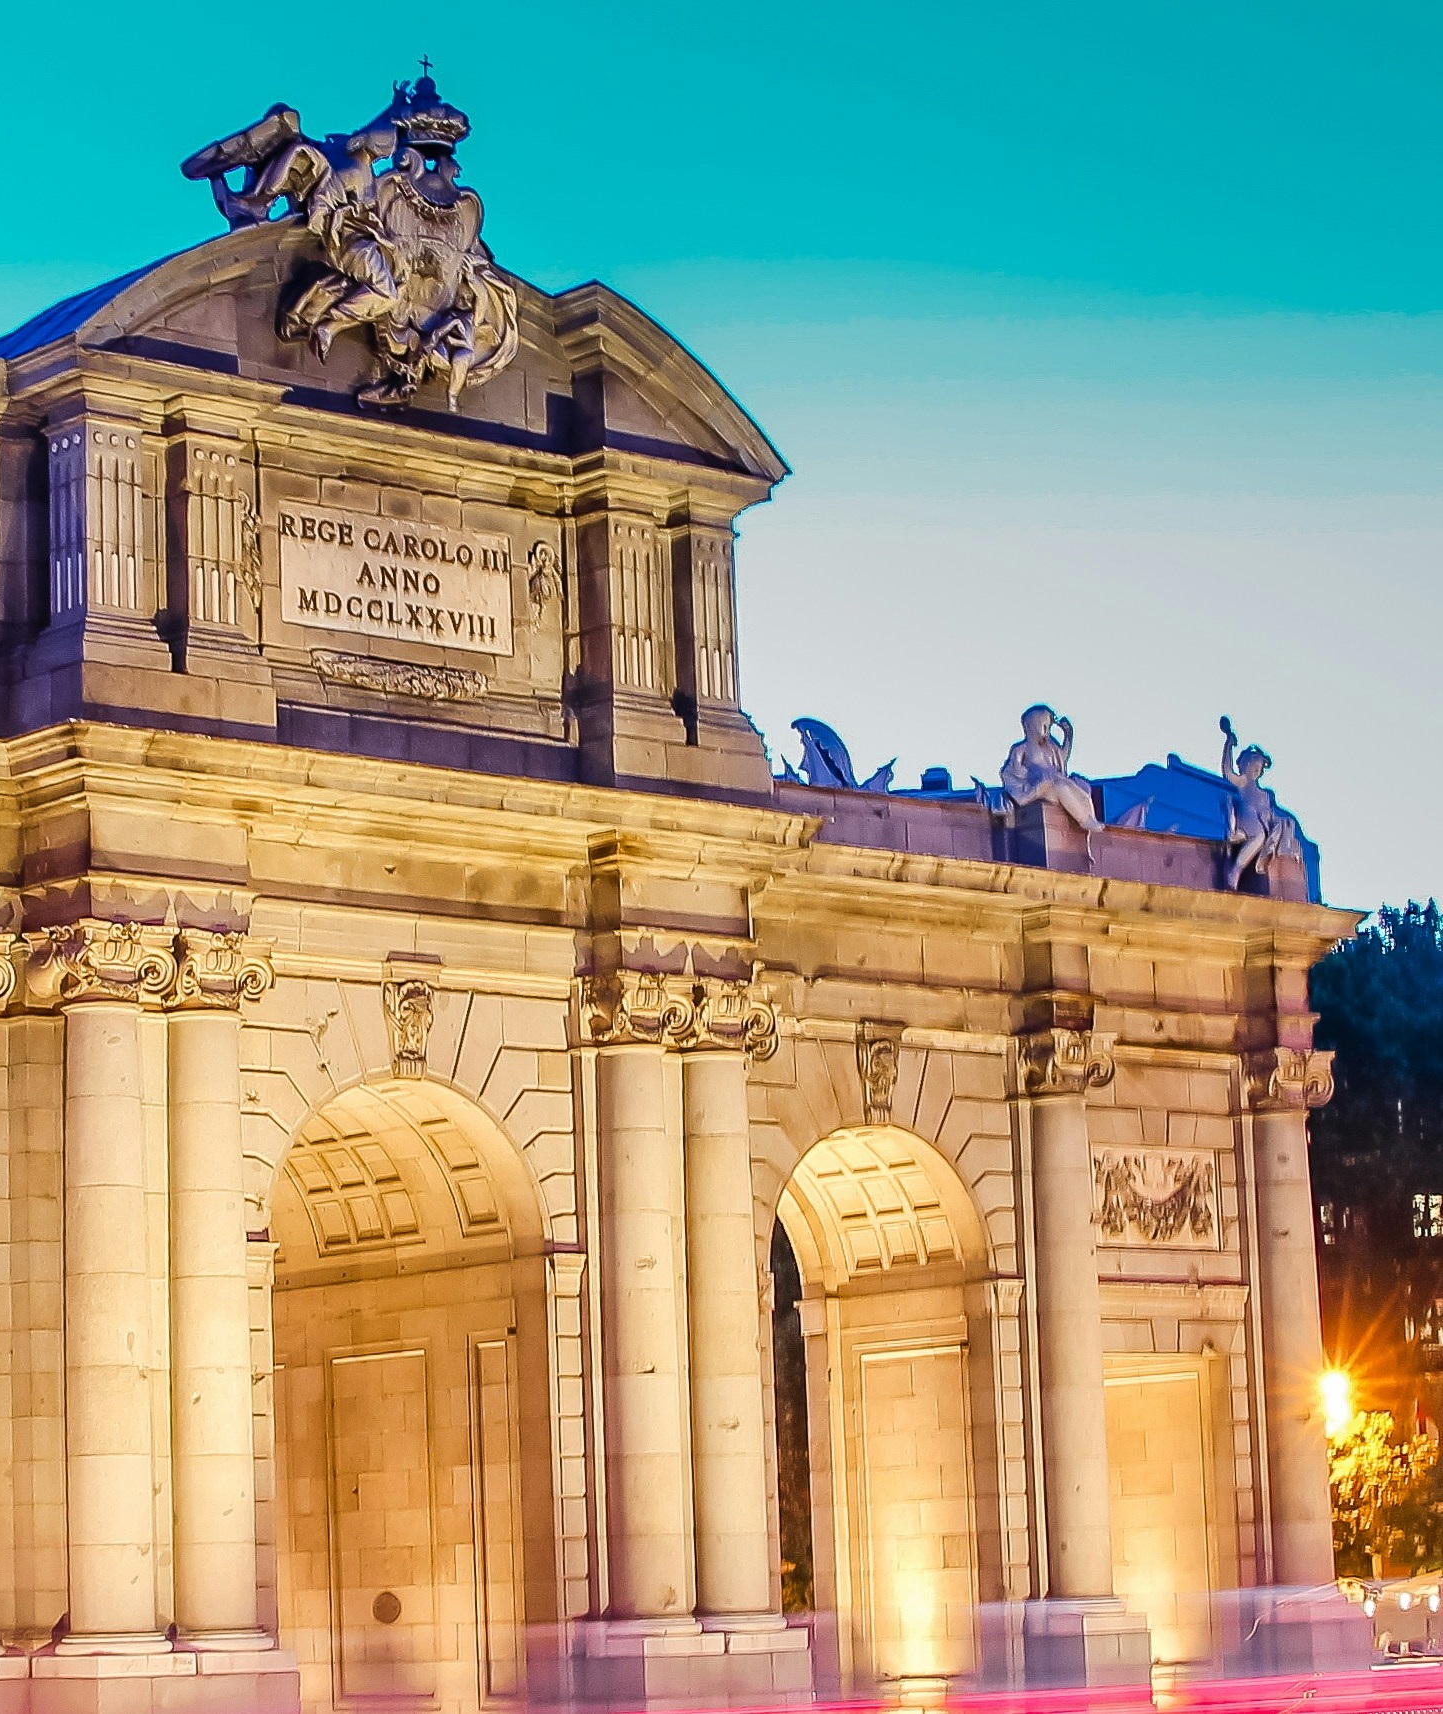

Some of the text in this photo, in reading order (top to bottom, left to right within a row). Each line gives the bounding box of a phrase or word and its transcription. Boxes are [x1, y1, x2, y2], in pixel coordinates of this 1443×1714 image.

[279, 513, 509, 573] REGE CAROLO III
[357, 562, 440, 594] ANNO
[297, 587, 496, 638] MDCCLXXVIII
